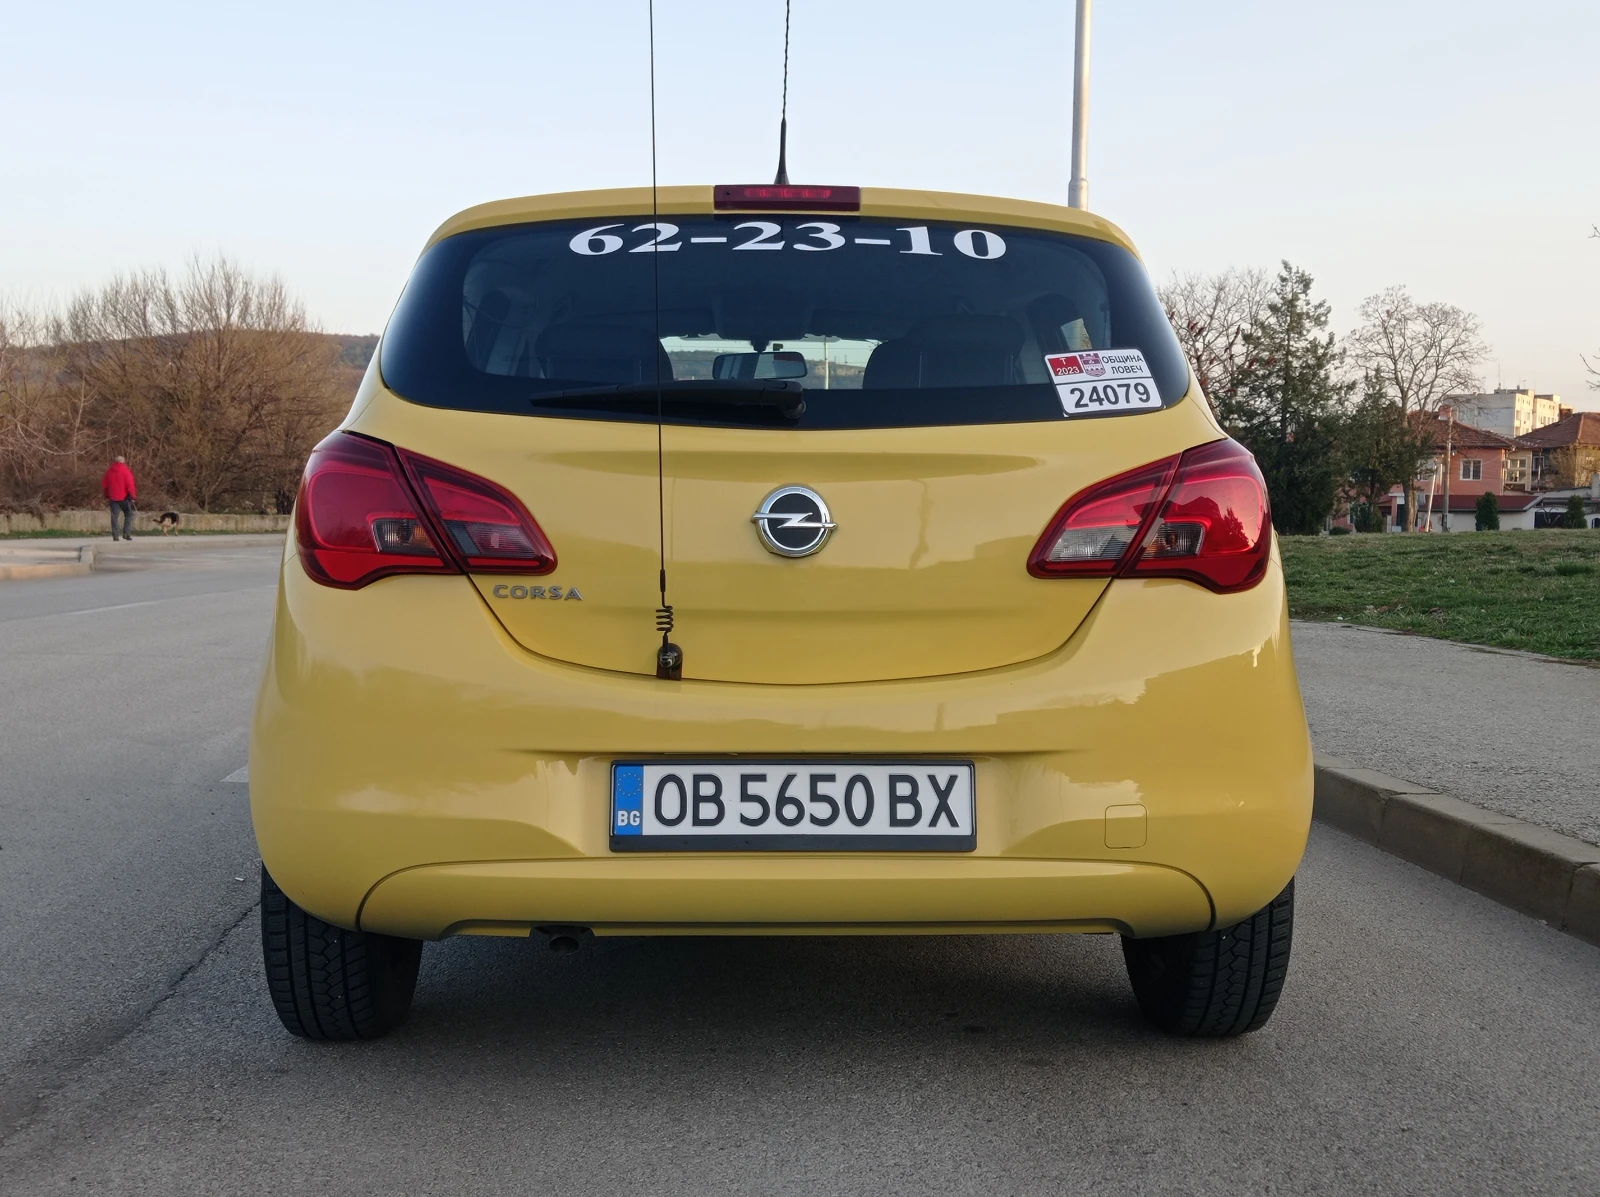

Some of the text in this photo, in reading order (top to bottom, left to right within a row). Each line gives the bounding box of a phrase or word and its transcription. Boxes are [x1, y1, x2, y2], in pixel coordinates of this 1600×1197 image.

[569, 221, 1007, 260] 62-23-10
[1101, 354, 1143, 364] ОБЩИНА
[1056, 366, 1080, 376] 2023
[1112, 365, 1143, 375] ЛОВЕЧ
[1069, 382, 1151, 409] 24079
[493, 584, 583, 601] CORSA
[654, 773, 960, 828] OB 5650 BX
[617, 810, 641, 826] BG
